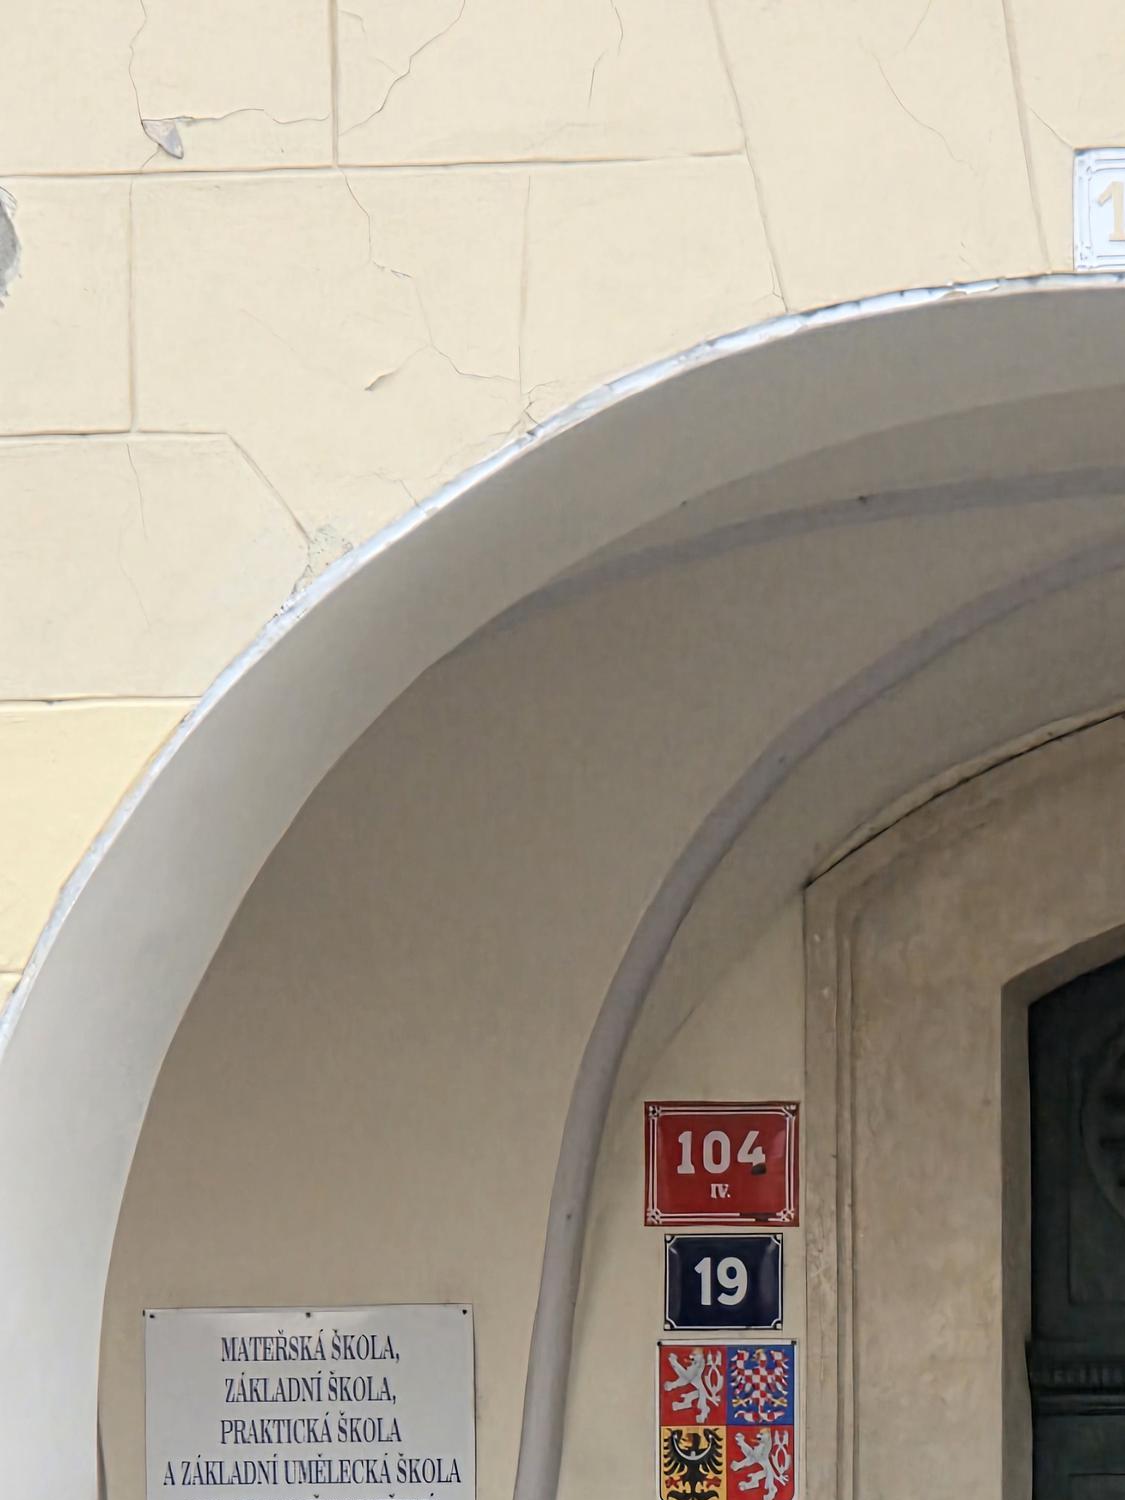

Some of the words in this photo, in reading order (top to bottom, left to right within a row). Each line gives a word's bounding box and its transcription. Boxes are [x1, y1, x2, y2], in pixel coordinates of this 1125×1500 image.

[677, 1130, 766, 1174] 104
[710, 1183, 731, 1199] IV.
[694, 1256, 748, 1306] 19
[221, 1329, 326, 1362] MATEŘSKÁ
[331, 1329, 401, 1364] ŠKOLA,
[225, 1371, 322, 1403] ZÁKLADNÍ
[328, 1370, 397, 1405] ŠKOLA,
[220, 1412, 332, 1445] PRAKTICKÁ
[337, 1411, 402, 1443] ŠKOLA
[163, 1461, 176, 1486] A
[181, 1453, 279, 1486] ZÁKLADNÍ
[284, 1453, 392, 1485] UMĚLECKÁ
[396, 1453, 461, 1484] ŠKOLA
